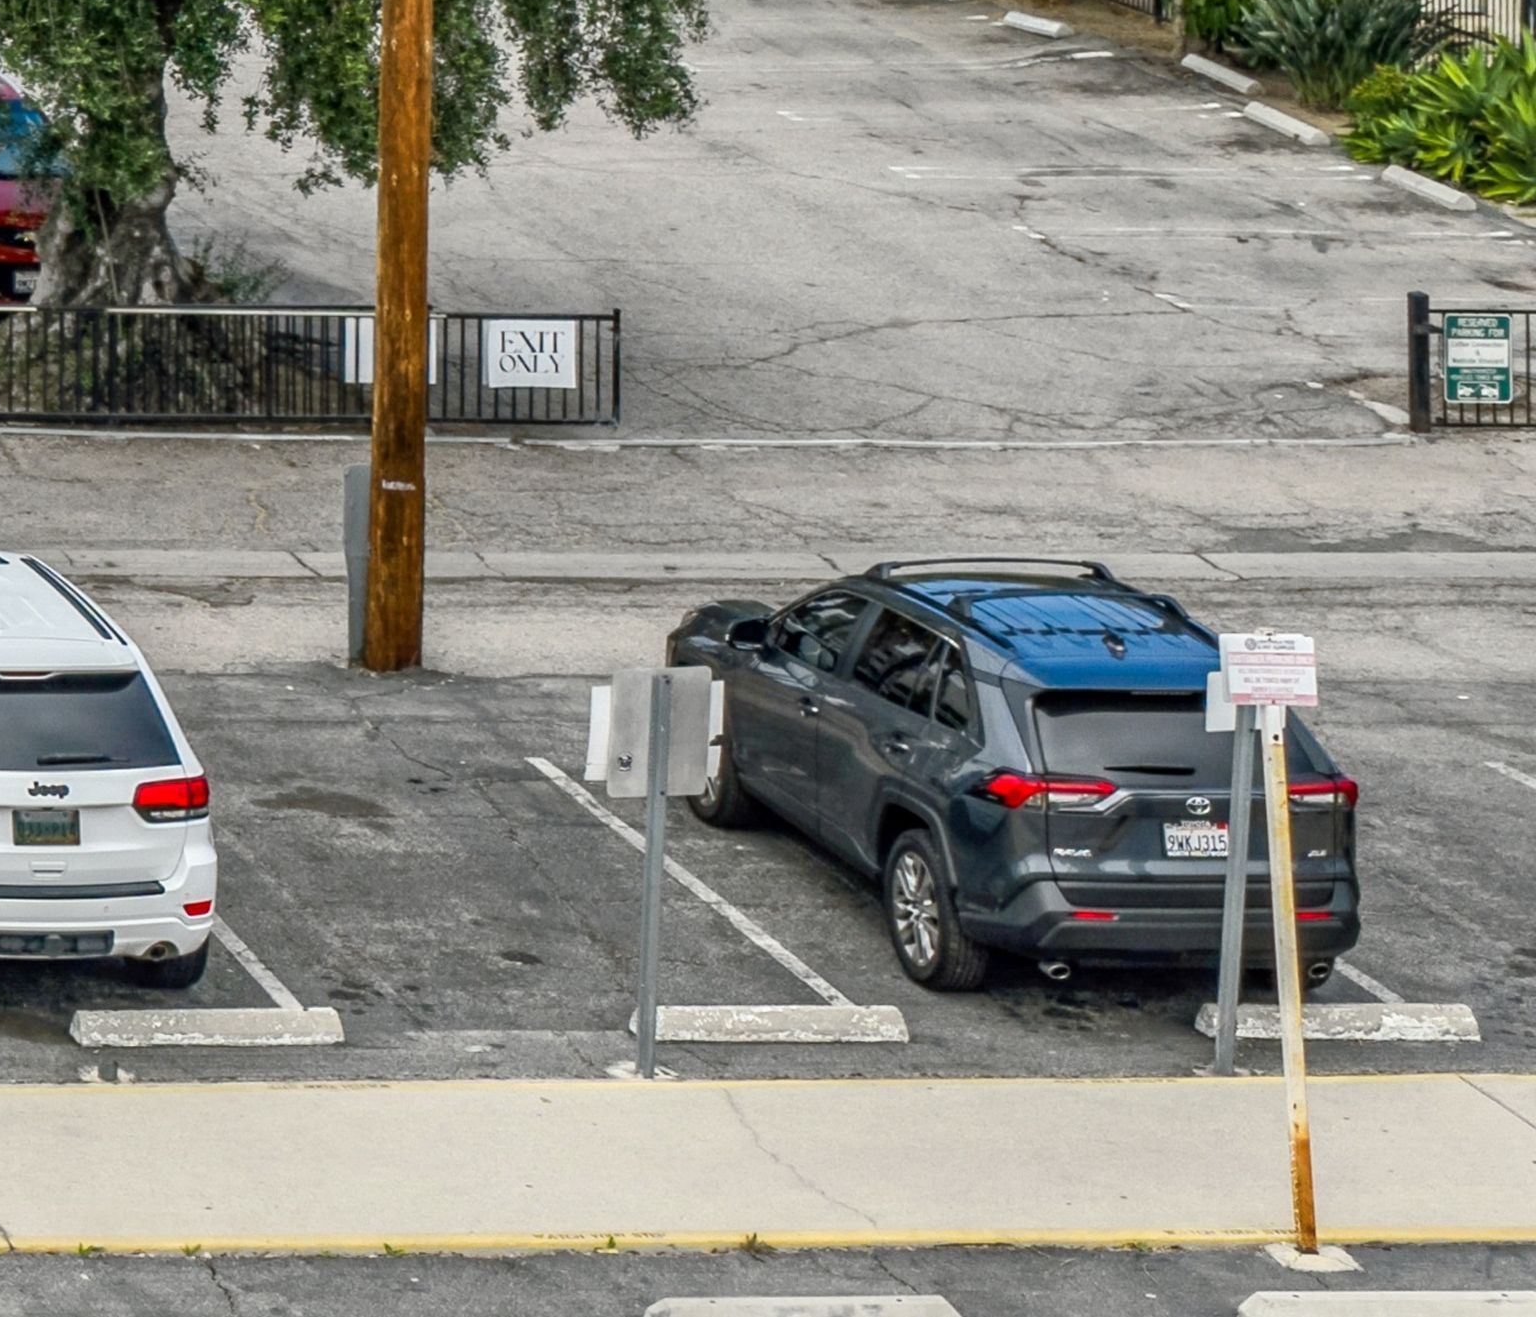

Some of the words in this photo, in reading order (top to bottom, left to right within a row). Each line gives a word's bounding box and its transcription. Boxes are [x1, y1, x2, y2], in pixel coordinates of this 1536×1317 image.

[500, 331, 566, 353] EXIT
[1451, 329, 1485, 338] PARKING
[1488, 329, 1504, 338] FOR
[499, 354, 565, 373] ONLY
[28, 781, 70, 799] Jeep
[1168, 835, 1227, 852] 9WKJ315
